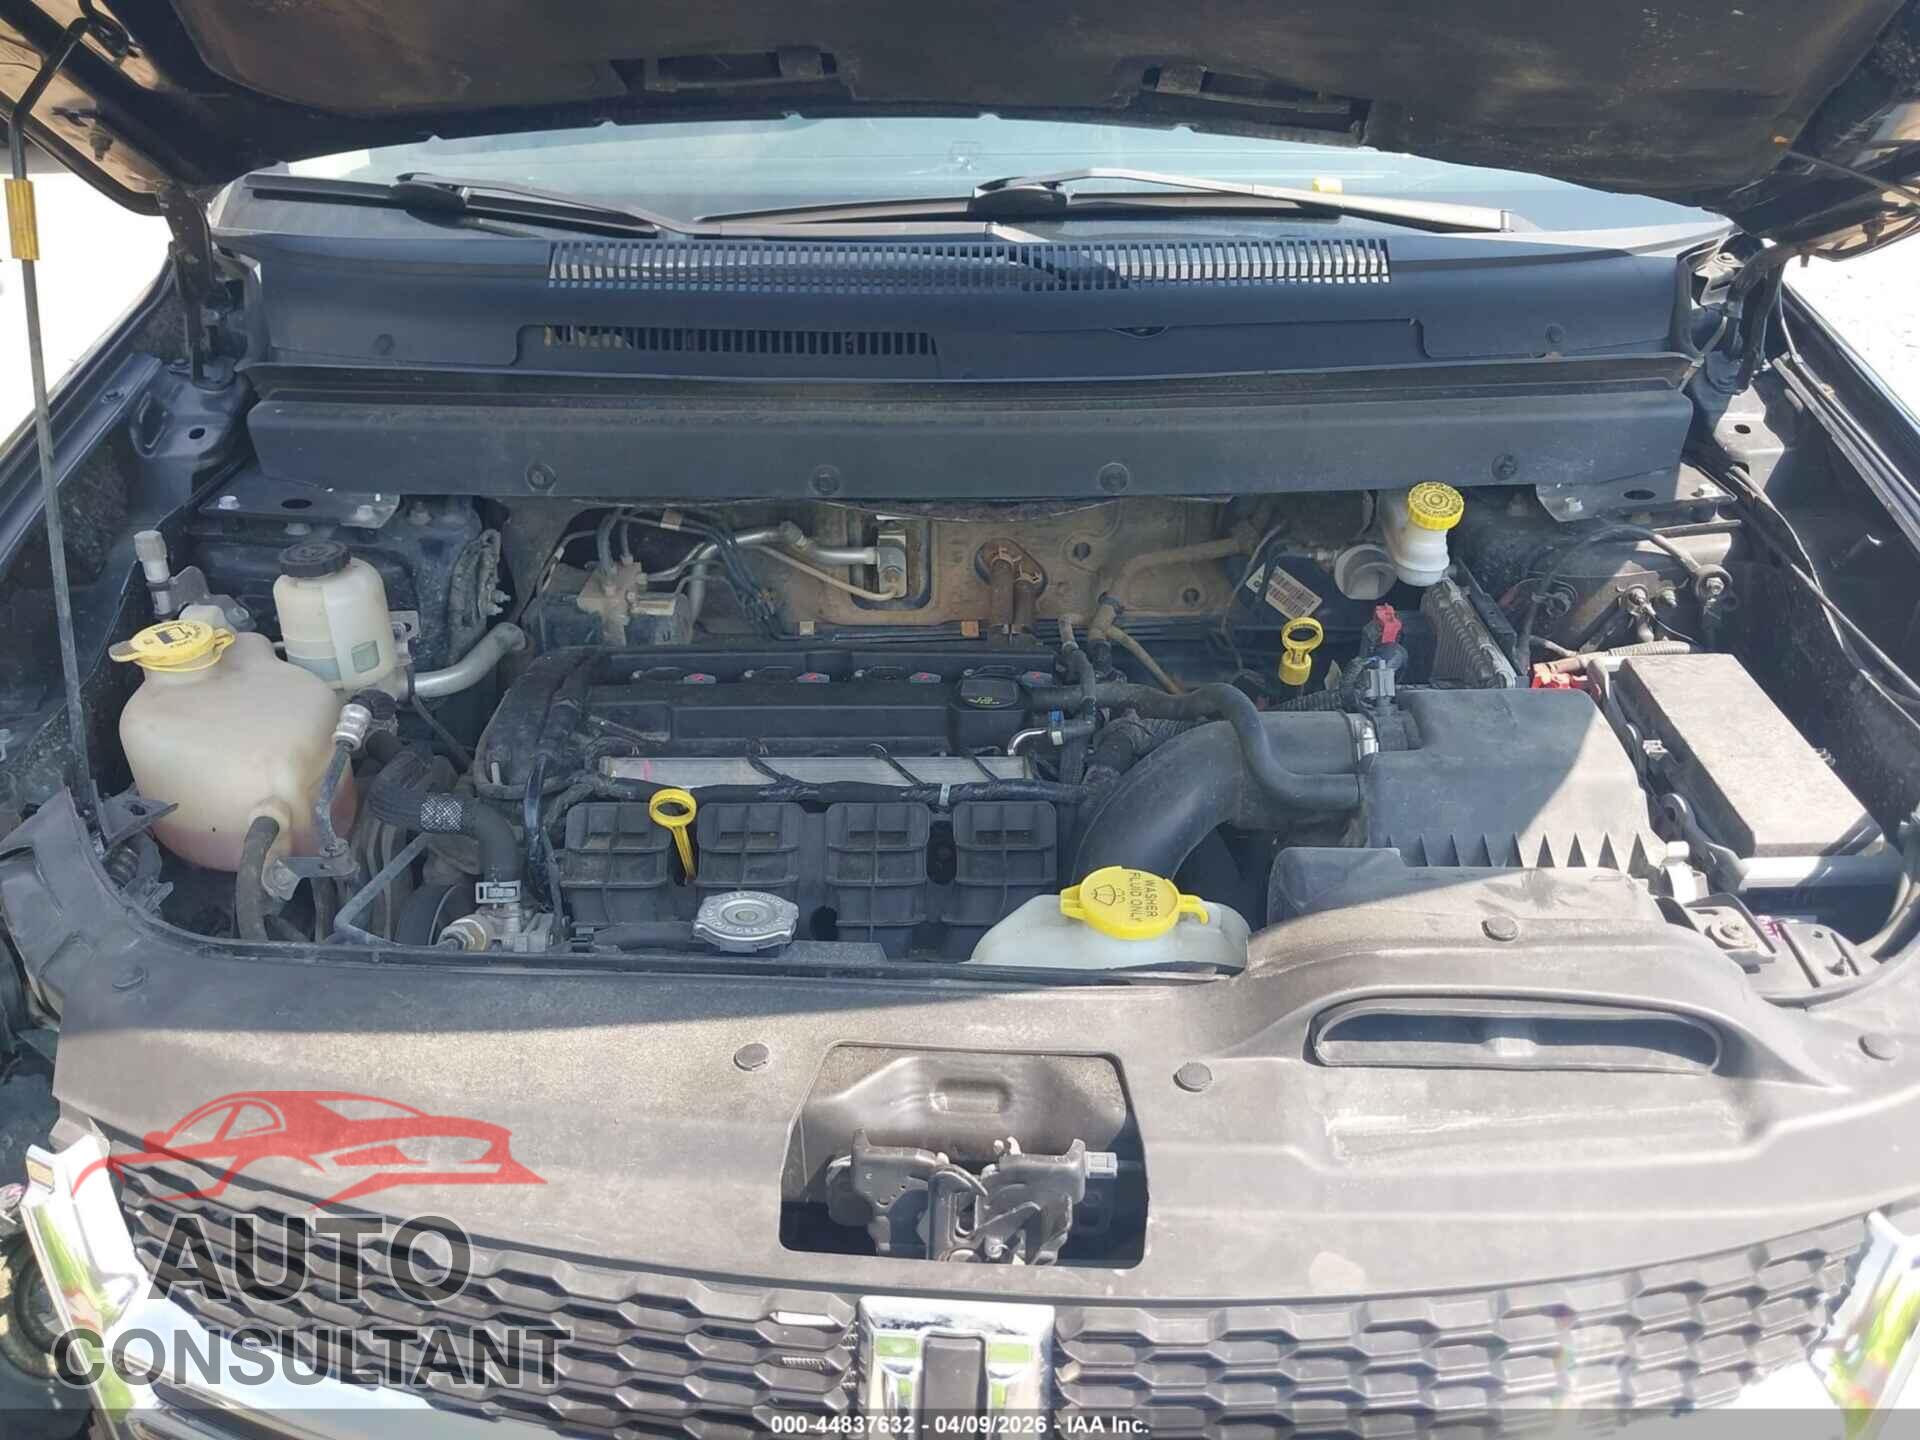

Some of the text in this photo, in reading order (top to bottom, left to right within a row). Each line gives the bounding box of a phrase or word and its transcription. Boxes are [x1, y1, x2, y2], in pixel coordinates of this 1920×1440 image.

[1128, 871, 1144, 922] FLUID ONLY
[1143, 879, 1159, 918] WASHER
